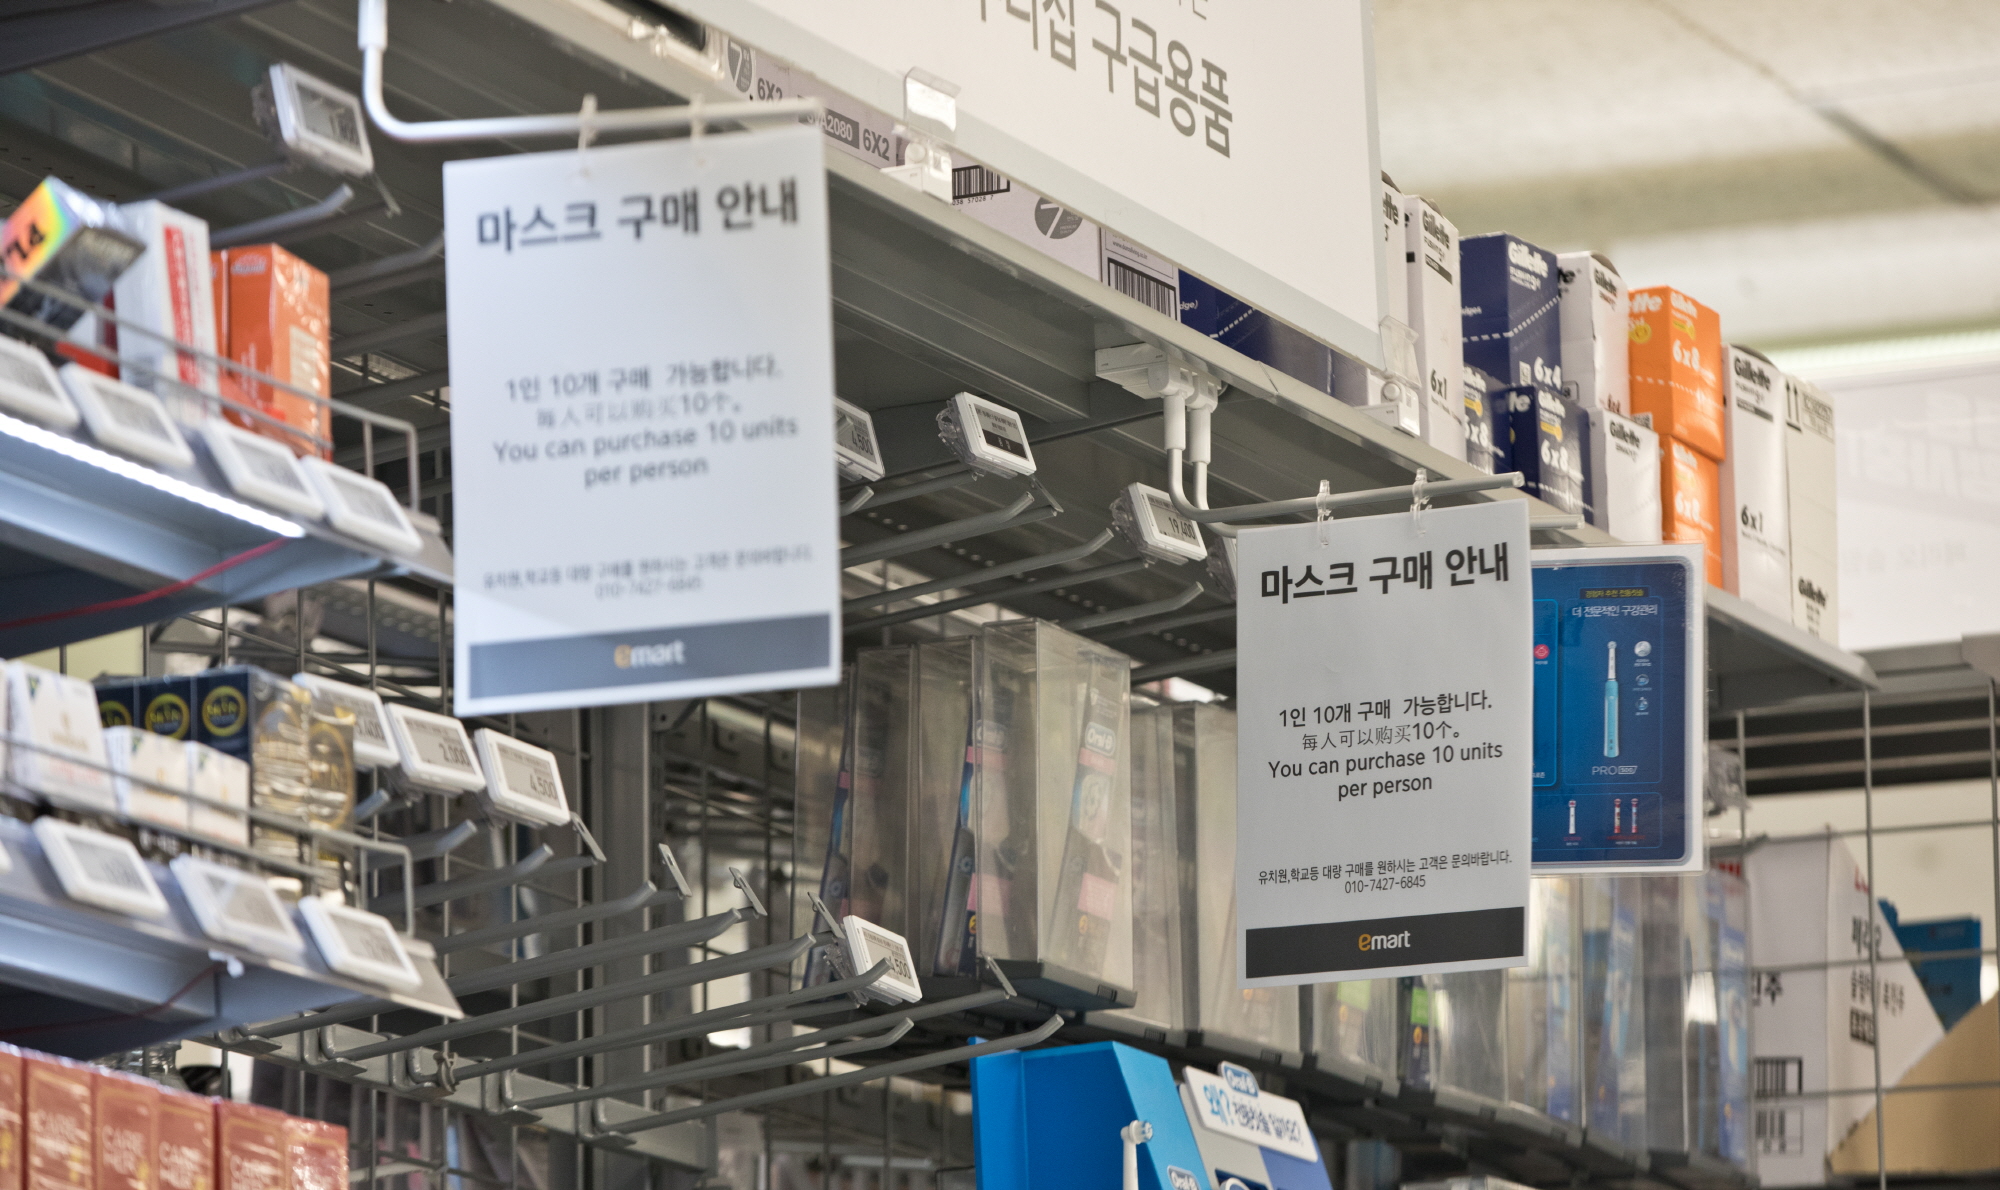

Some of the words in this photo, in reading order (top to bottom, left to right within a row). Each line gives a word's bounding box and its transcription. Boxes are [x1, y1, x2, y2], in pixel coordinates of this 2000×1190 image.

[1092, 0, 1233, 159] 구급용품
[863, 128, 891, 162] 6X2
[477, 204, 604, 254] 마스크
[616, 186, 701, 240] 구매
[715, 176, 798, 231] 안내
[1508, 240, 1549, 279] Gillette
[1672, 339, 1700, 372] 6x8
[505, 376, 541, 402] 1인
[551, 370, 599, 397] 10개
[608, 366, 651, 393] 구매
[667, 353, 783, 387] 가능합니다.
[1430, 369, 1448, 400] 6x1
[1534, 356, 1562, 390] 6x4
[1733, 355, 1771, 391] Gillette
[493, 440, 540, 463] You
[545, 436, 586, 459] can
[593, 425, 698, 457] purchase
[708, 419, 736, 443] 10
[742, 415, 799, 440] units
[1609, 419, 1640, 449] Gillette
[585, 463, 621, 490] per
[631, 456, 709, 486] person
[1541, 439, 1569, 473] 6x8
[1741, 504, 1763, 533] 6x1
[1261, 562, 1358, 604] 마스크
[1369, 551, 1433, 595] 구매
[1445, 542, 1509, 587] 안내
[1572, 606, 1582, 617] 더
[1583, 605, 1620, 618] 전문적인
[1621, 603, 1658, 617] 구강관리
[614, 640, 685, 669] emart
[1279, 707, 1306, 728] 1인
[1313, 702, 1352, 725] 10개
[1357, 699, 1391, 722] 구매
[1403, 690, 1492, 717] 가능합니다.
[1302, 720, 1460, 751] 每人可以购买10个。
[1268, 761, 1303, 778] You
[1308, 758, 1339, 776] can
[1346, 751, 1426, 776] purchase
[1432, 745, 1455, 764] 10
[1460, 742, 1503, 761] units
[1592, 765, 1617, 776] PRO
[530, 774, 558, 800] 4,500
[1338, 782, 1368, 802] per
[1373, 776, 1433, 799] person
[1258, 866, 1319, 886] 유치원,학교등
[1322, 864, 1342, 880] 대량
[1344, 861, 1374, 878] 구매를
[1376, 857, 1416, 876] 원하시는
[1419, 854, 1448, 871] 고객은
[1451, 849, 1513, 869] 문의바랍니다.
[1344, 874, 1427, 895] 010-7427-6845
[1358, 930, 1411, 952] emart
